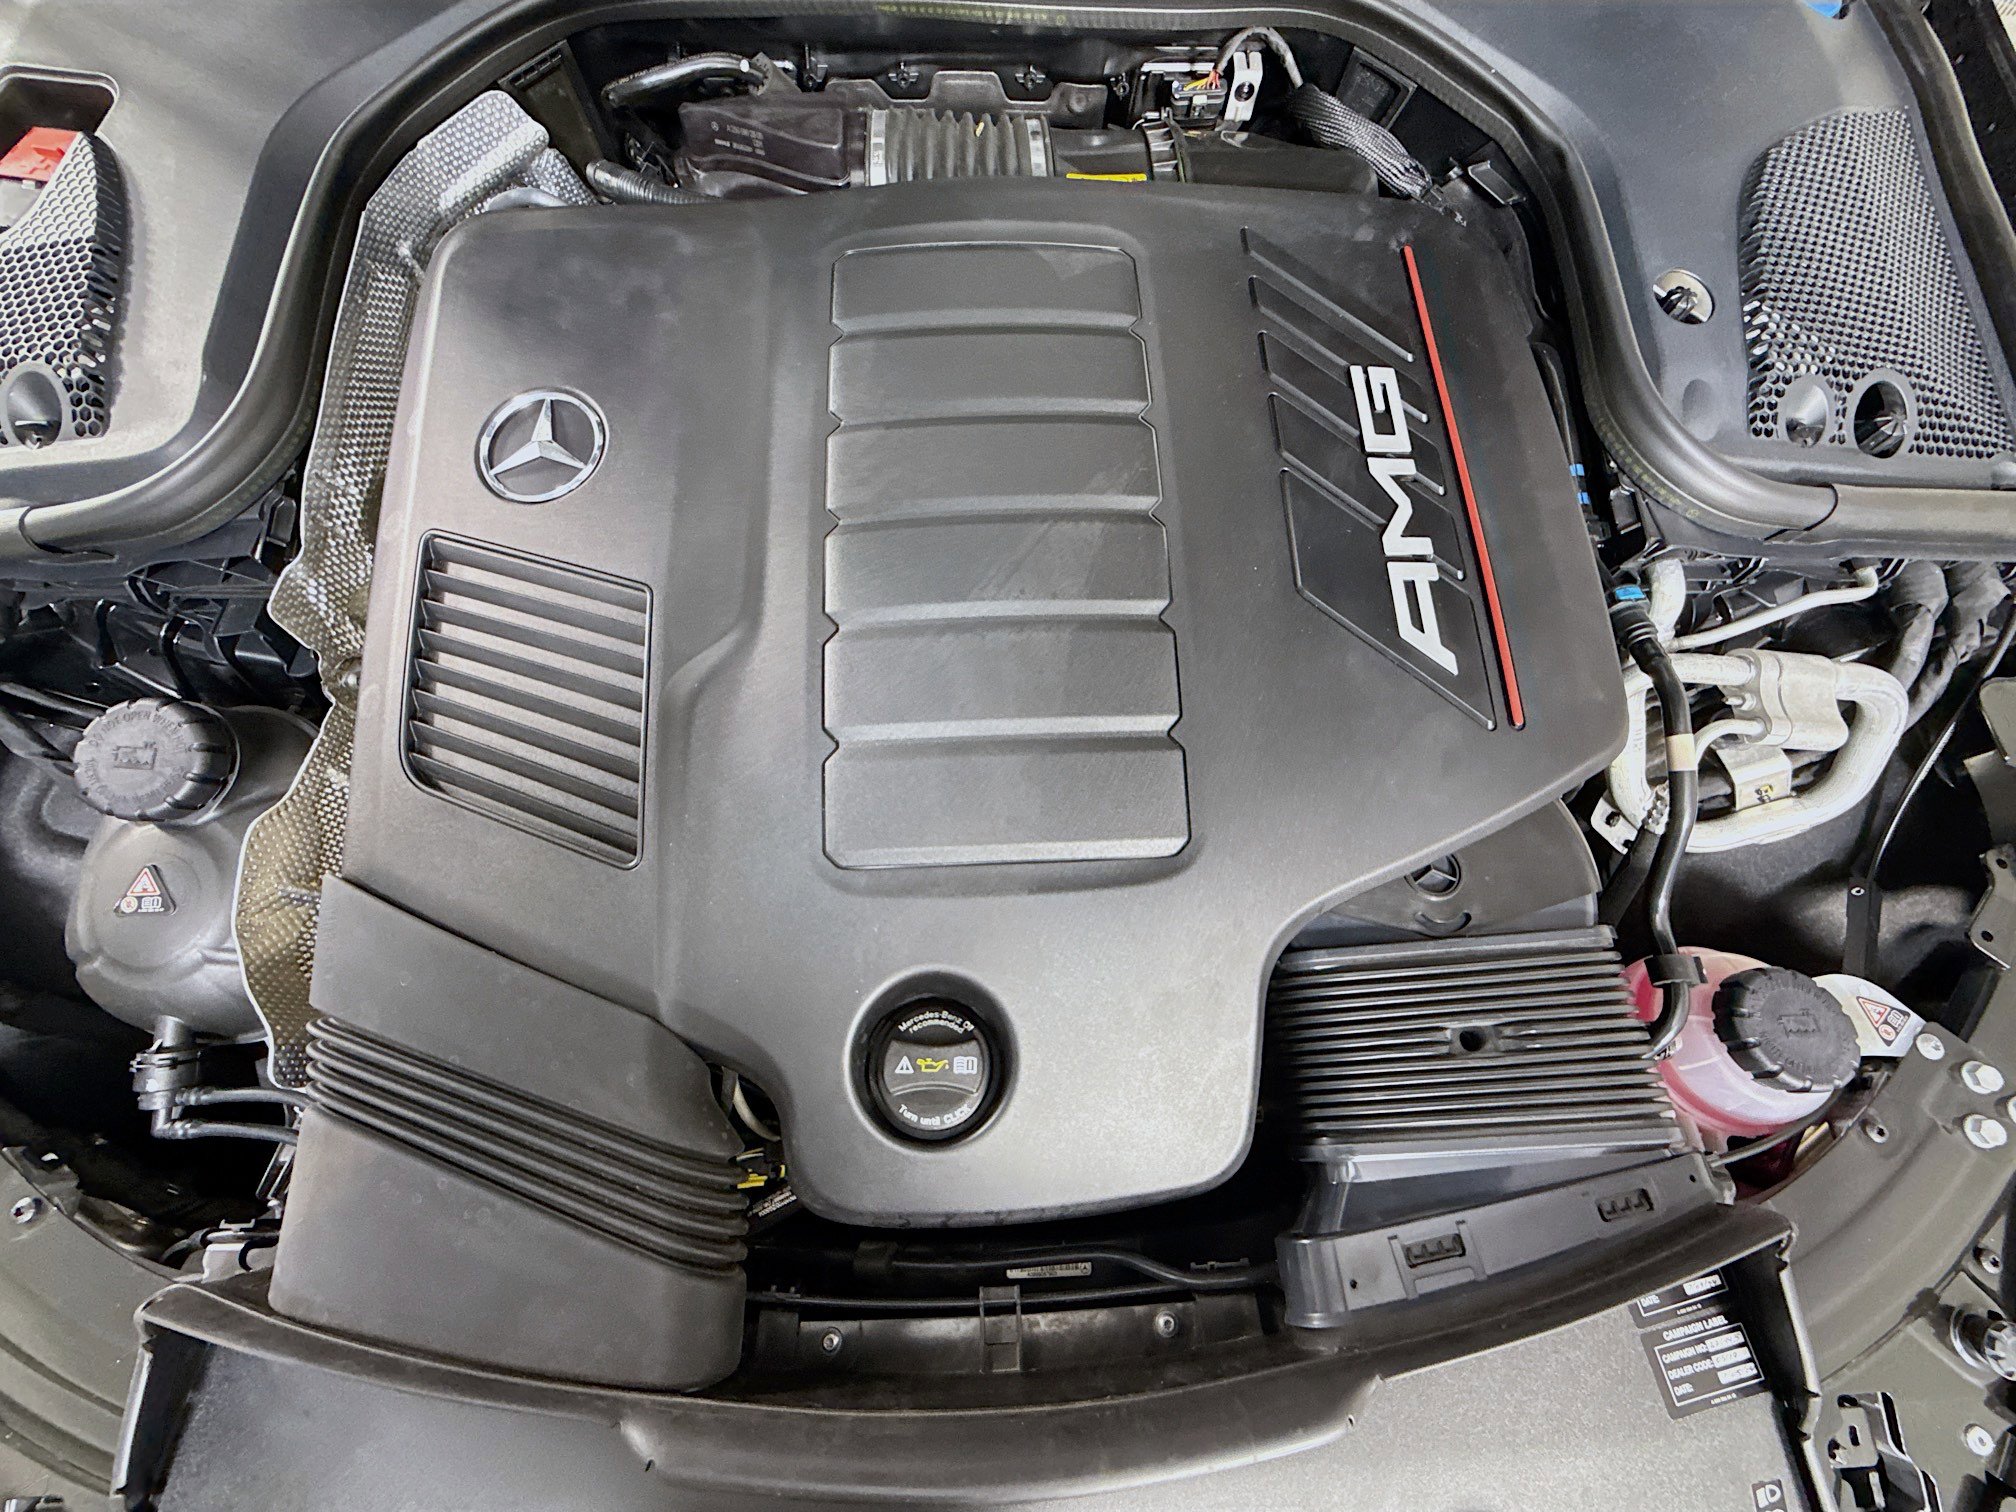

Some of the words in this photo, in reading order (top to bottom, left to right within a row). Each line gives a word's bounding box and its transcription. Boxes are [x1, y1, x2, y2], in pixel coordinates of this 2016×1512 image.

[1350, 365, 1458, 676] AMG
[122, 710, 152, 722] OPEN
[898, 1010, 963, 1032] Mercedes-Benz
[909, 1019, 965, 1034] recommended
[899, 1104, 918, 1123] Turn
[920, 1116, 940, 1126] until
[943, 1103, 971, 1124] CLICK
[1640, 1295, 1661, 1307] DATE:
[1662, 1321, 1704, 1341] CAMPAIGN
[1703, 1315, 1728, 1330] LABEL
[1662, 1346, 1697, 1364] CAMPAIGN
[1667, 1364, 1695, 1380] DEALER
[1673, 1383, 1694, 1397] DATE:
